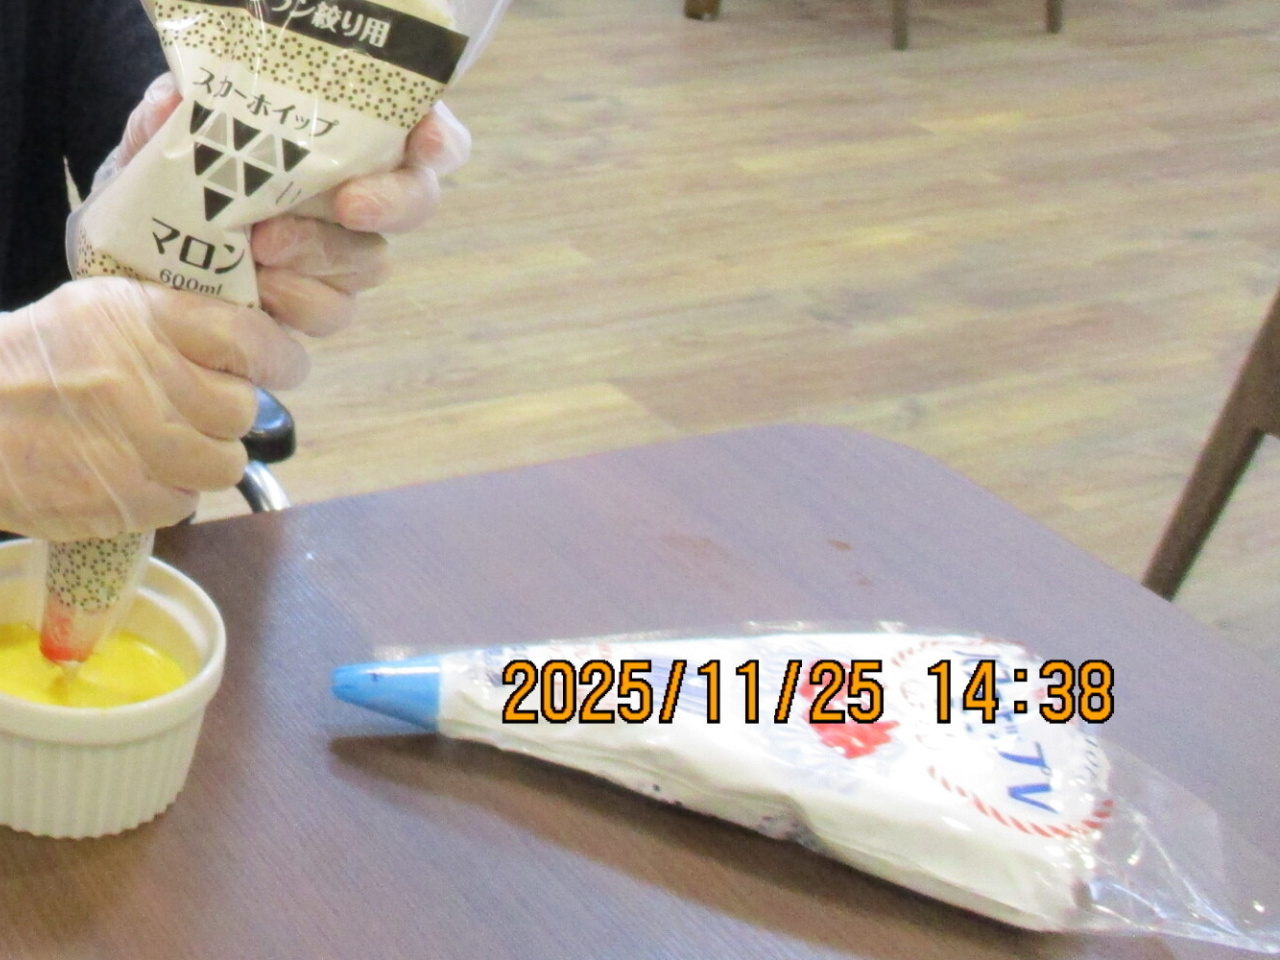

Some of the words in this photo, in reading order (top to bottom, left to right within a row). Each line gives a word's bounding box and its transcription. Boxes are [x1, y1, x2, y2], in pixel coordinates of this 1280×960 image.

[192, 66, 340, 137] スカーホイップ
[151, 216, 246, 275] マロン
[159, 268, 223, 296] 600ml
